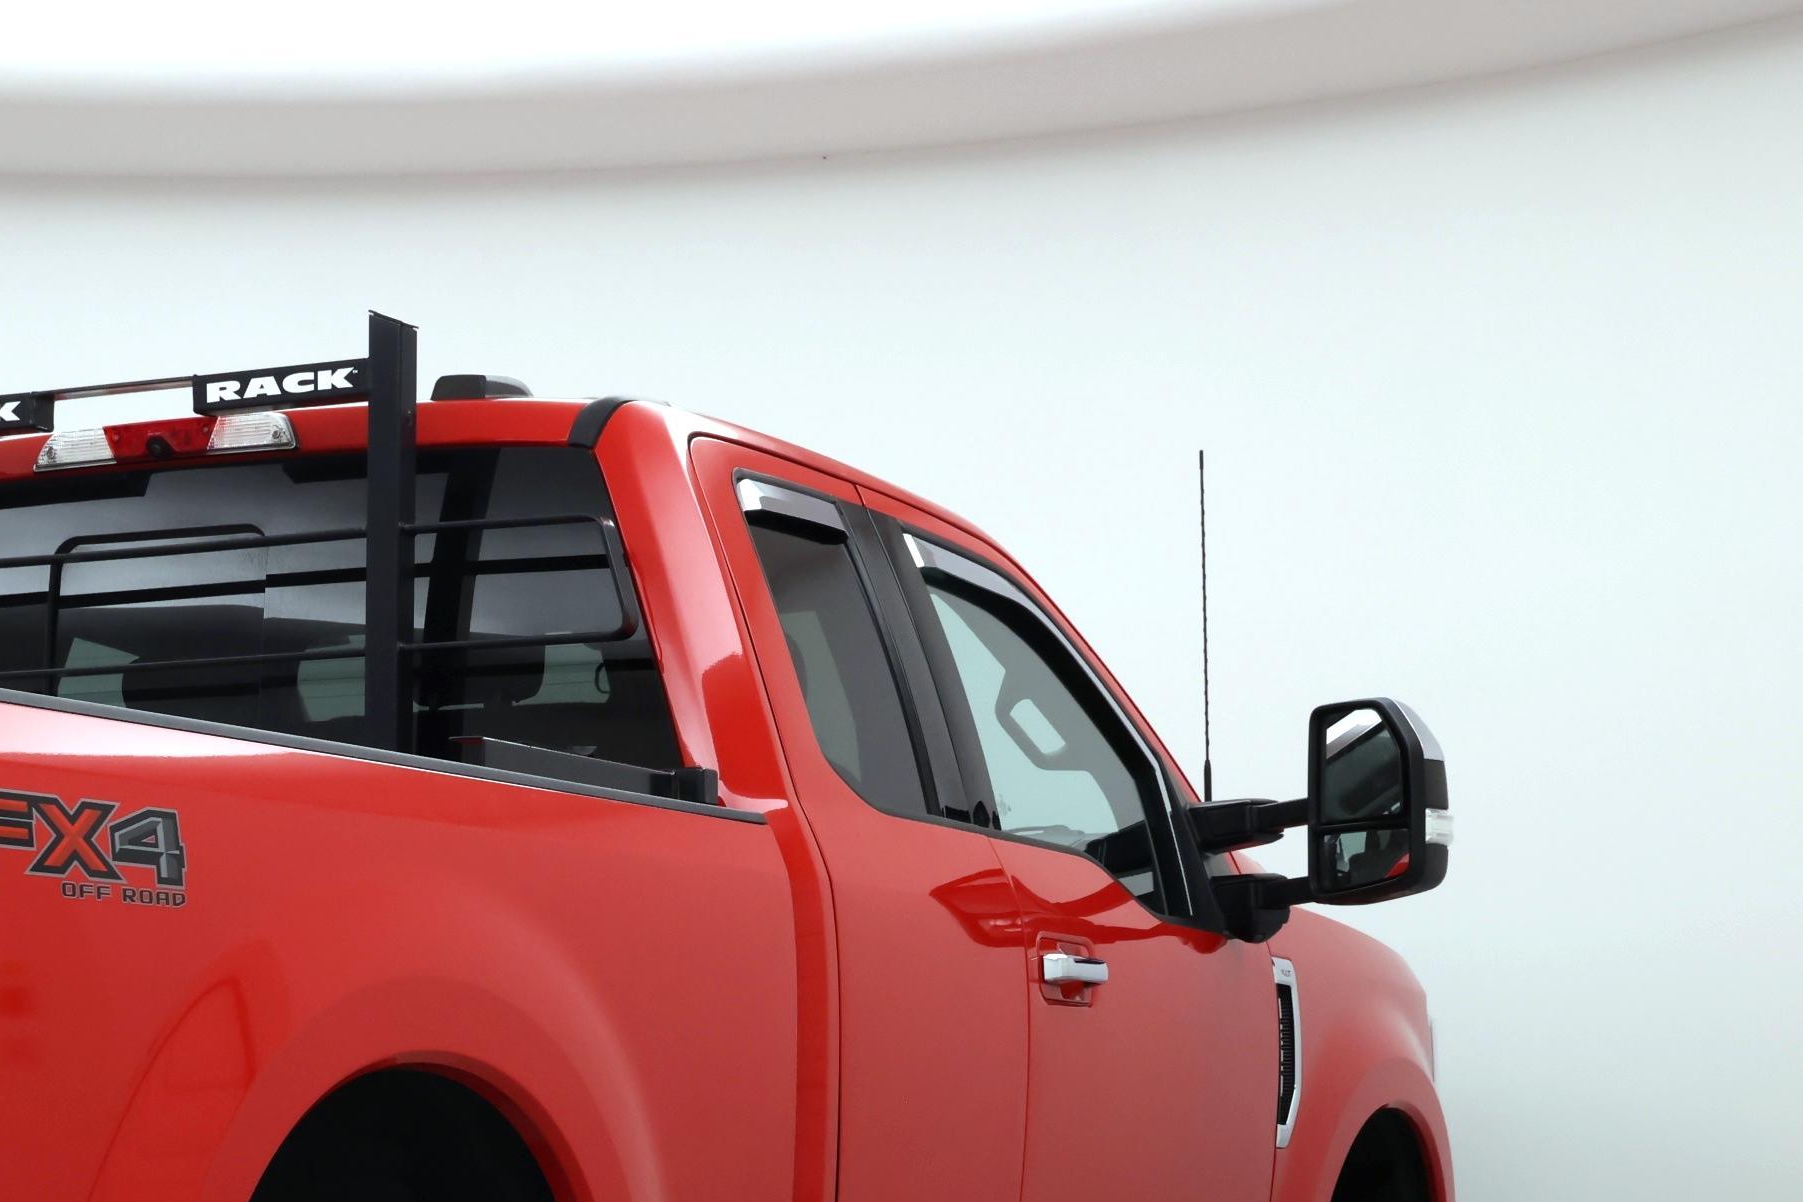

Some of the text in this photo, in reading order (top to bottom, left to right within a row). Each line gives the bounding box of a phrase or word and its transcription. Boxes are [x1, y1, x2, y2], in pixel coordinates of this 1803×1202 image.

[206, 366, 355, 404] RACK
[61, 881, 186, 908] OFF ROAD
